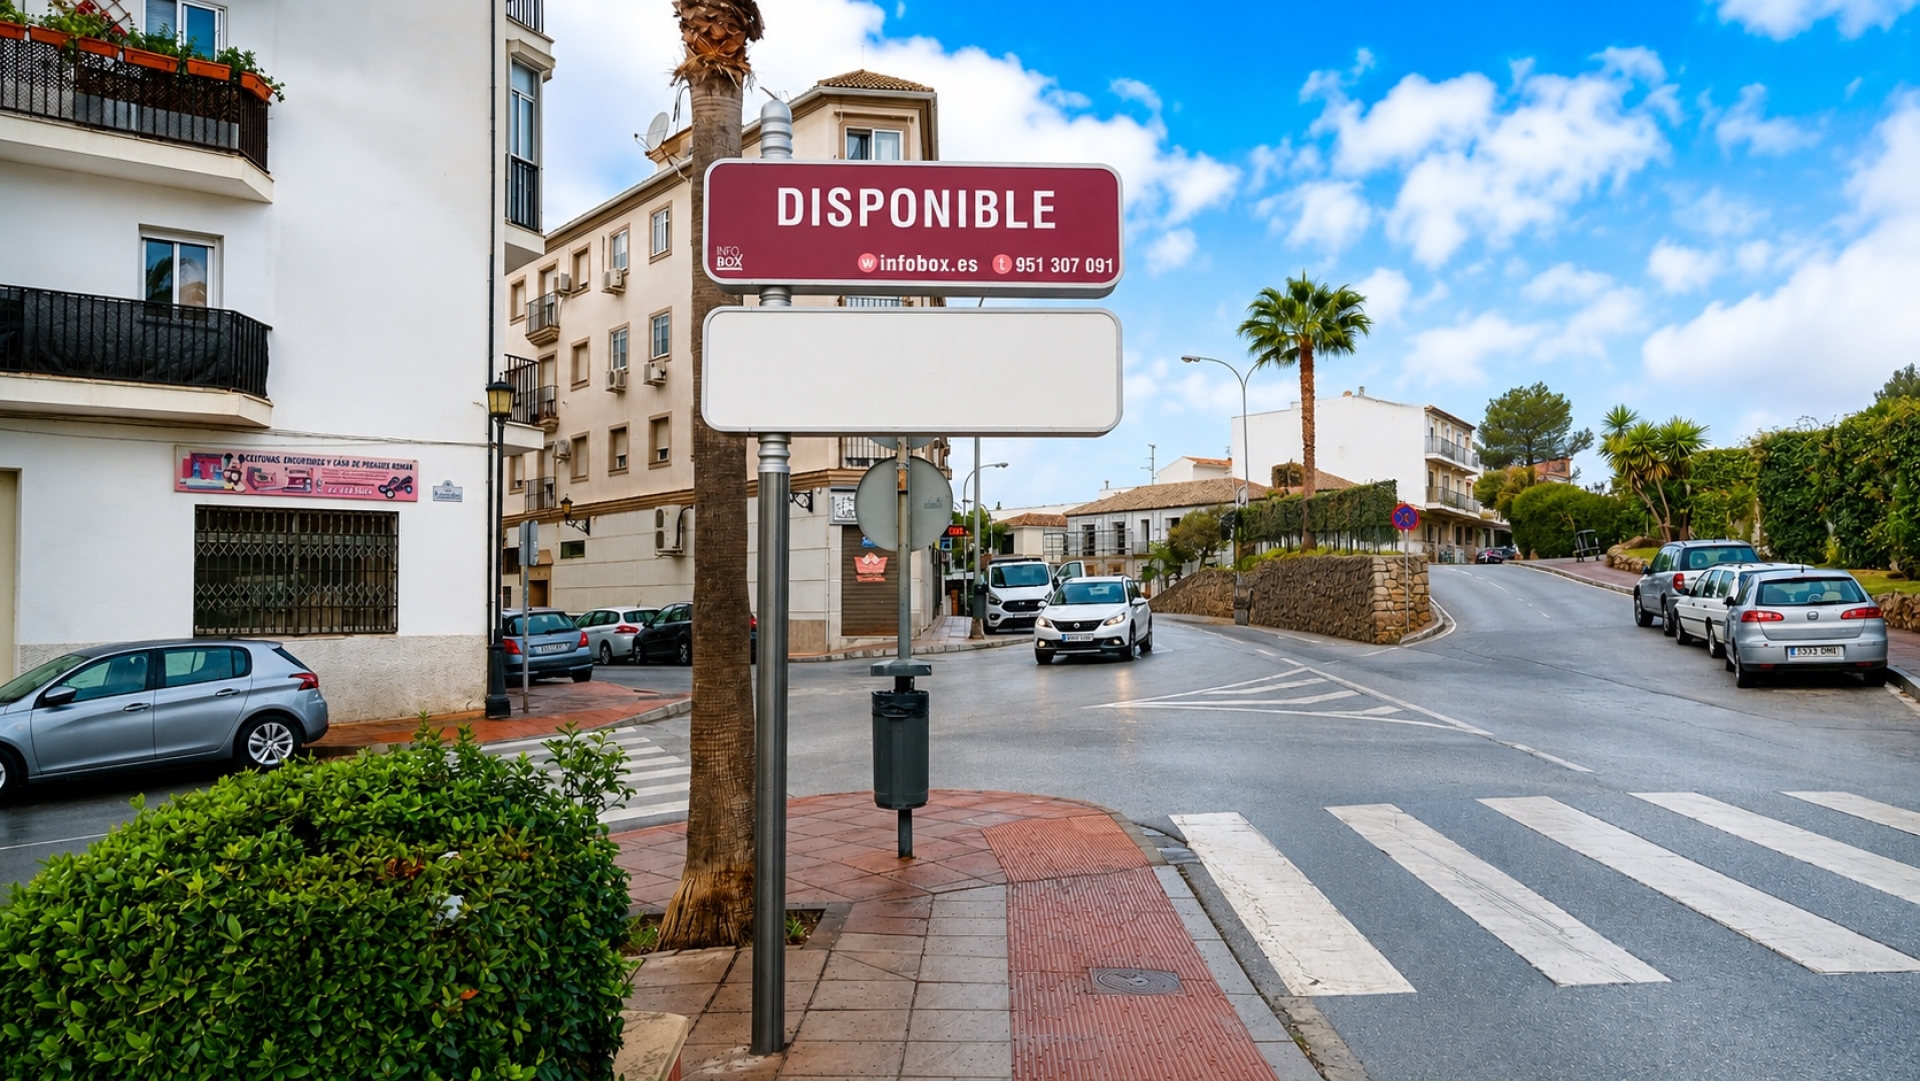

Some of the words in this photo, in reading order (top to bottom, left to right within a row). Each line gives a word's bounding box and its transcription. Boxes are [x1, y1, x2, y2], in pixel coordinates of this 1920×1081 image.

[777, 186, 1056, 229] DISPONIBLE
[716, 245, 740, 255] INFO
[716, 253, 744, 270] BOX
[880, 254, 978, 272] infobox.es
[1015, 256, 1043, 273] 951
[1050, 257, 1079, 273] 307
[1085, 257, 1113, 273] 091
